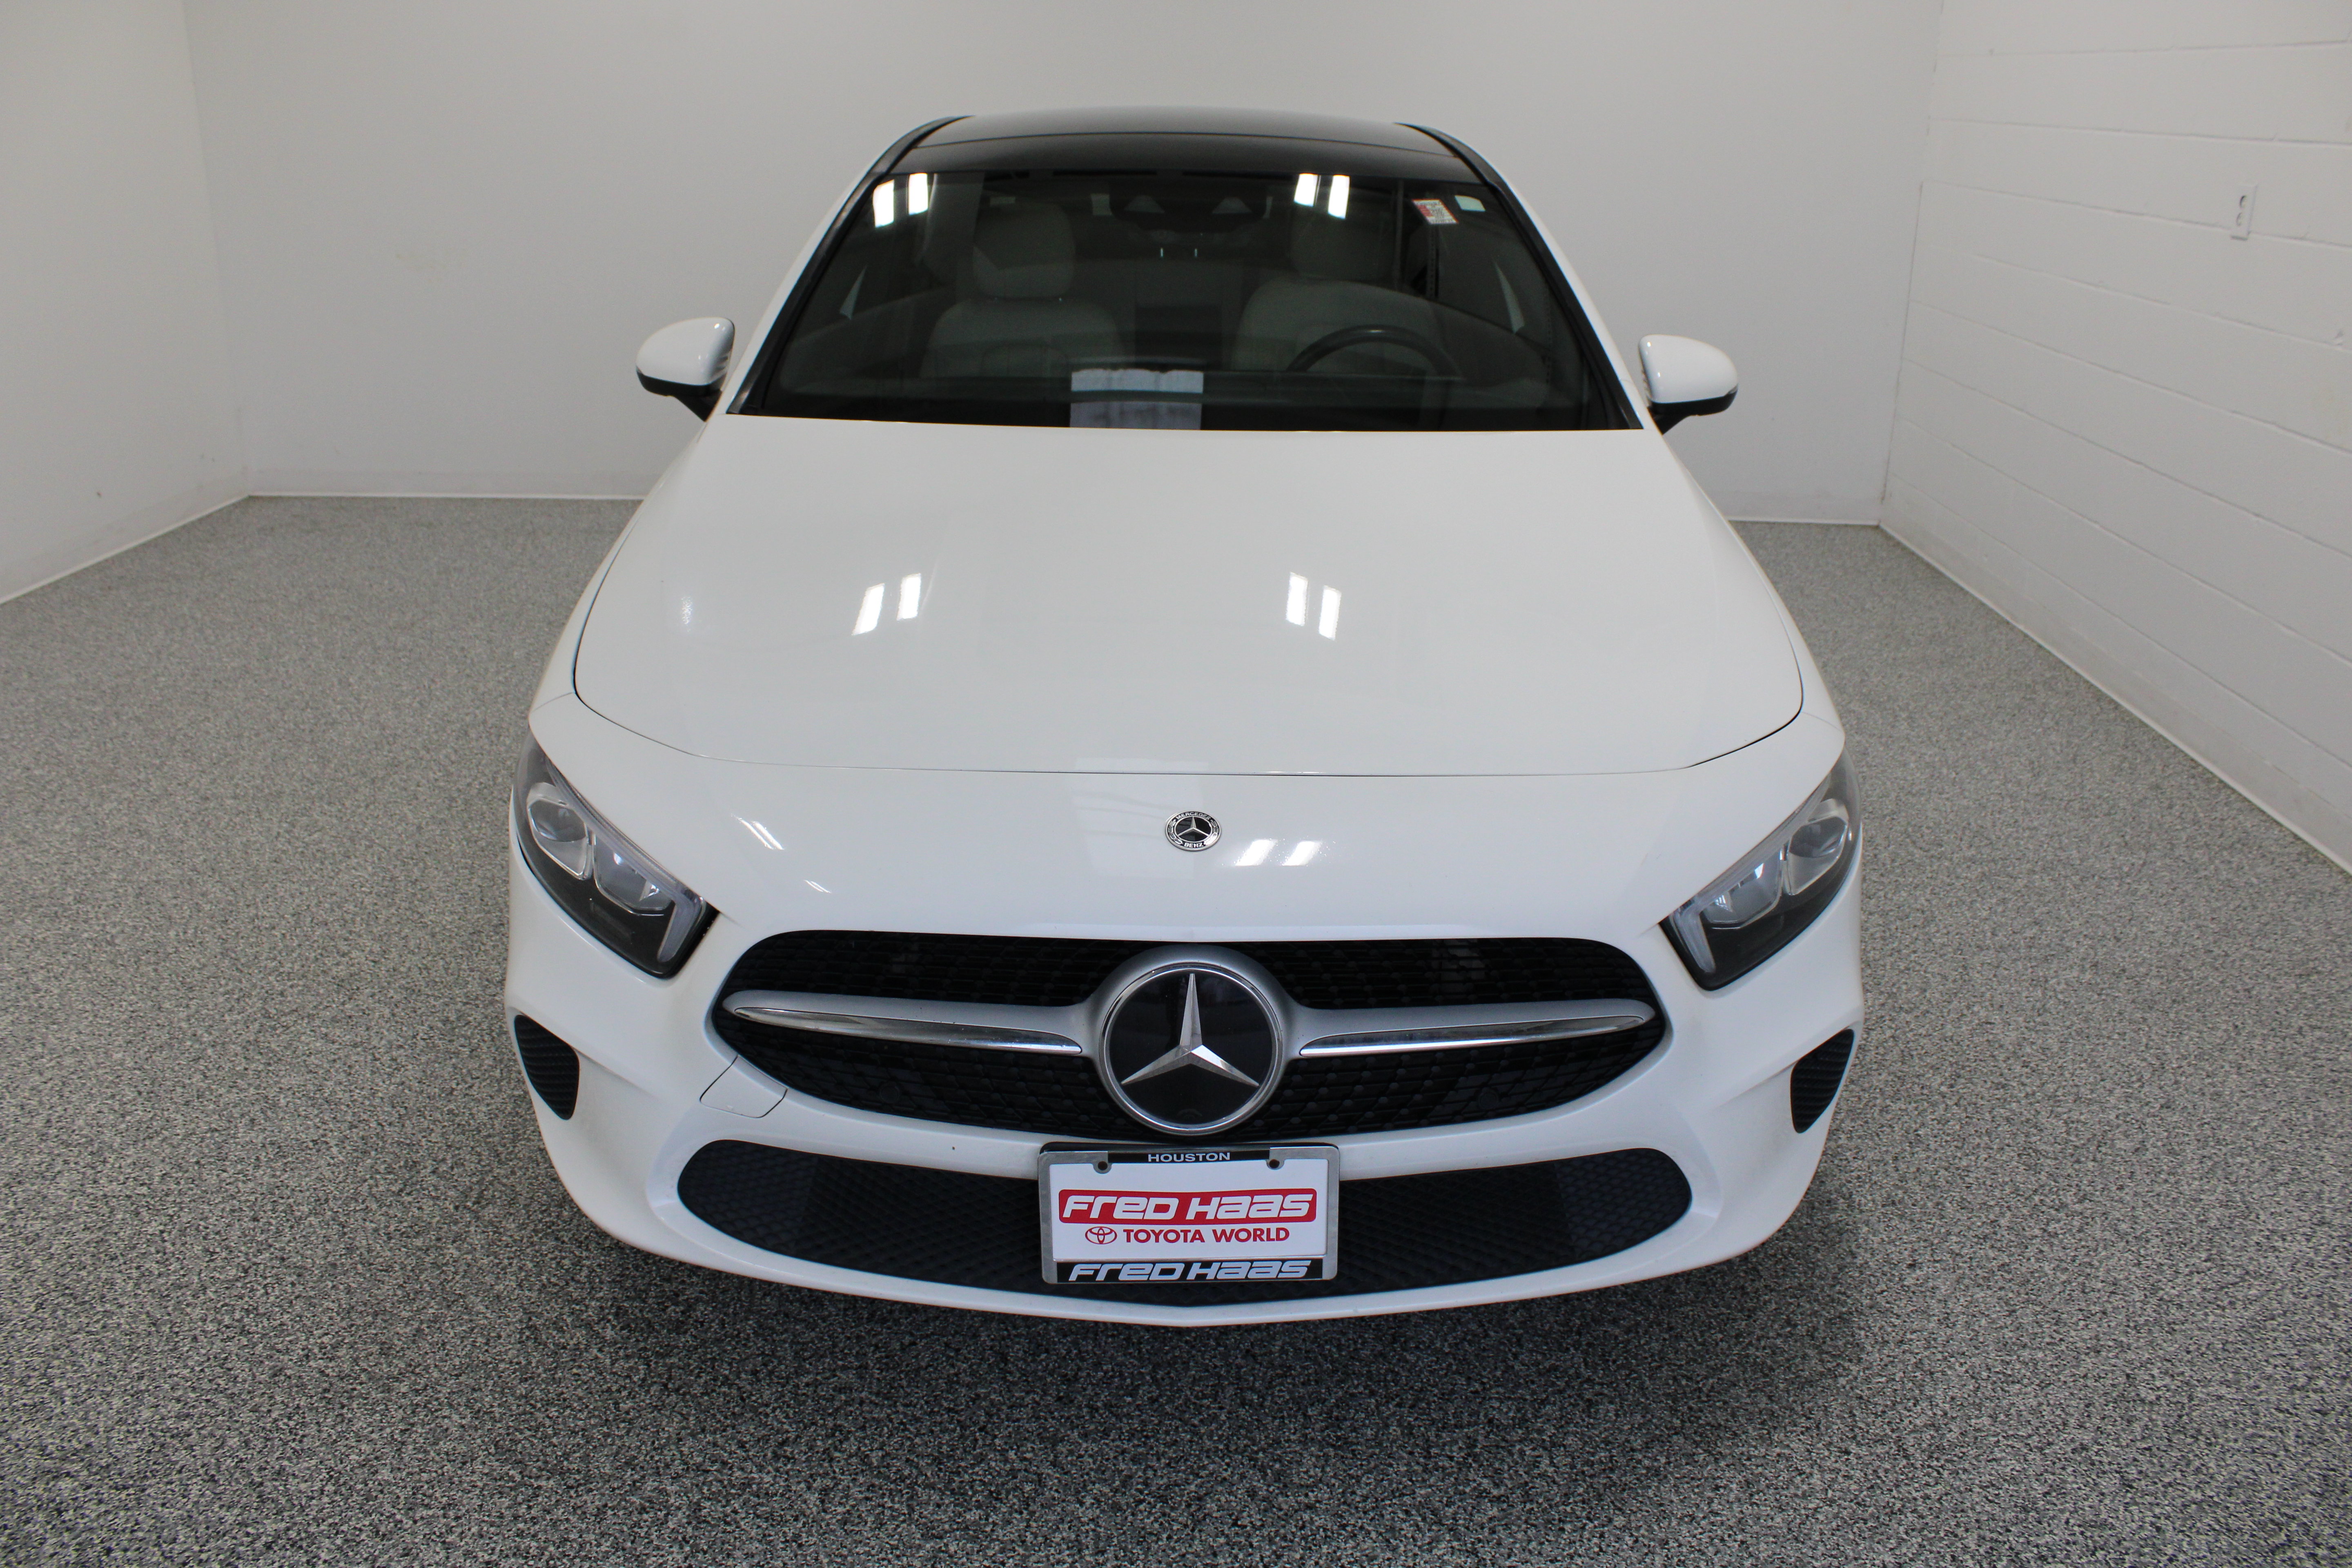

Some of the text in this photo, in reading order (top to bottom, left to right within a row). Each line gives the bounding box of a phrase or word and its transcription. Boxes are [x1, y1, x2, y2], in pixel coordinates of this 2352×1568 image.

[1176, 812, 1211, 820] MERCEDES
[1148, 1152, 1230, 1162] HOUSTON
[1123, 1227, 1290, 1243] TOYOTA WORLD
